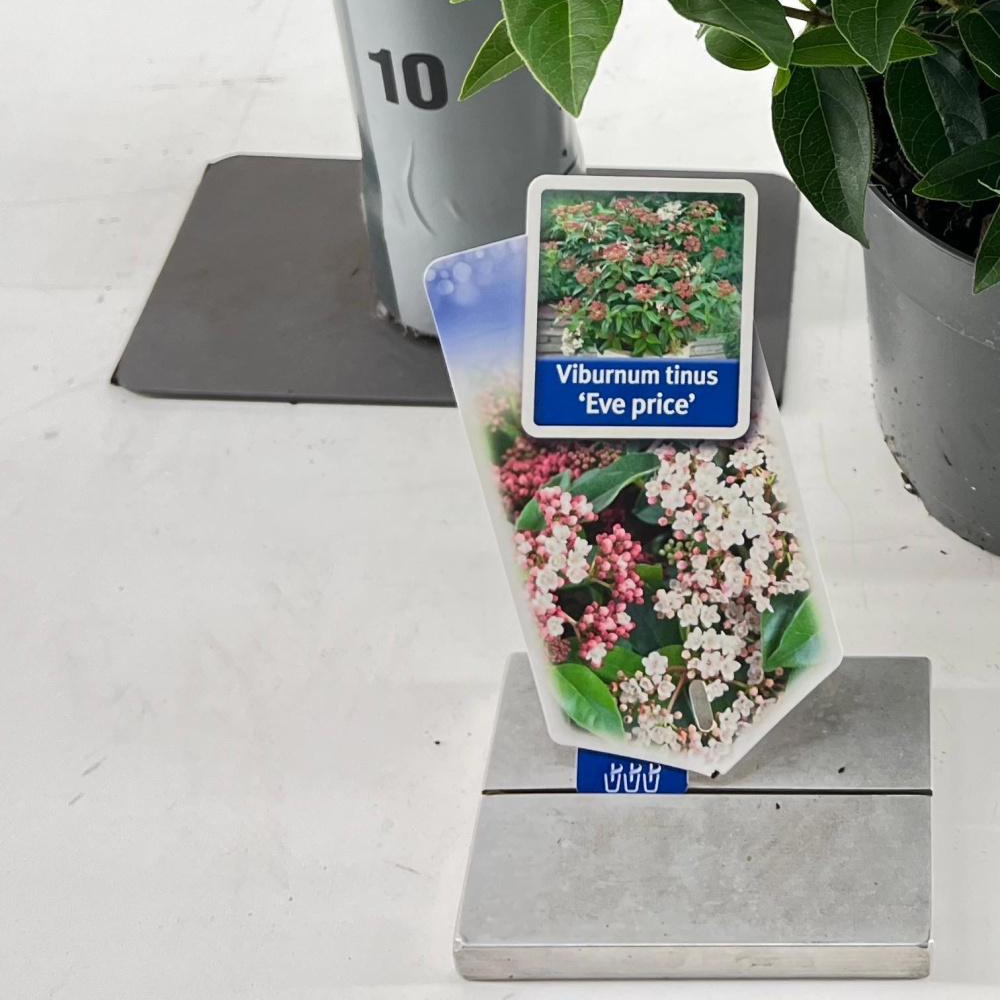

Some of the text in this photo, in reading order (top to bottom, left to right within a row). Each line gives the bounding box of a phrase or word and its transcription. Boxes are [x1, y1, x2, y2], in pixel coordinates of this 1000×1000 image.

[368, 48, 448, 111] 10
[556, 363, 719, 386] Viburnum tinus
[578, 392, 696, 421] ‘Eve price’
